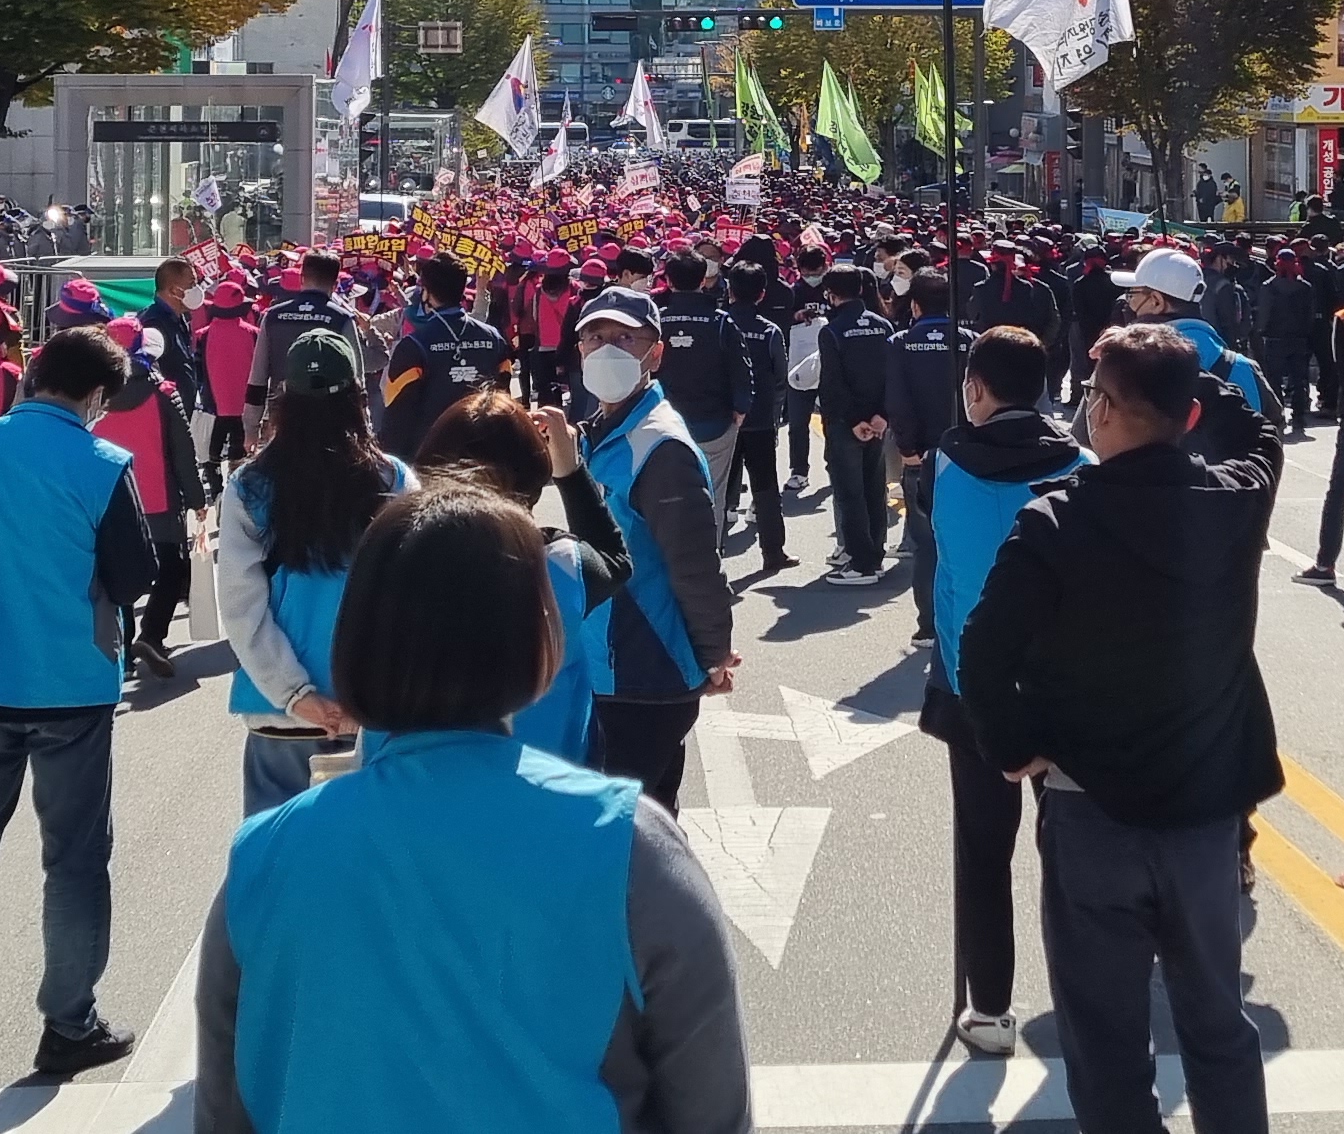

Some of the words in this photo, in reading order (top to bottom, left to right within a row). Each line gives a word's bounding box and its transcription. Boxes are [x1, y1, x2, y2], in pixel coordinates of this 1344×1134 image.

[1322, 139, 1334, 163] 개성
[558, 219, 598, 240] 총파업
[566, 235, 593, 253] 승리
[430, 339, 493, 352] 국민건강험노동조합
